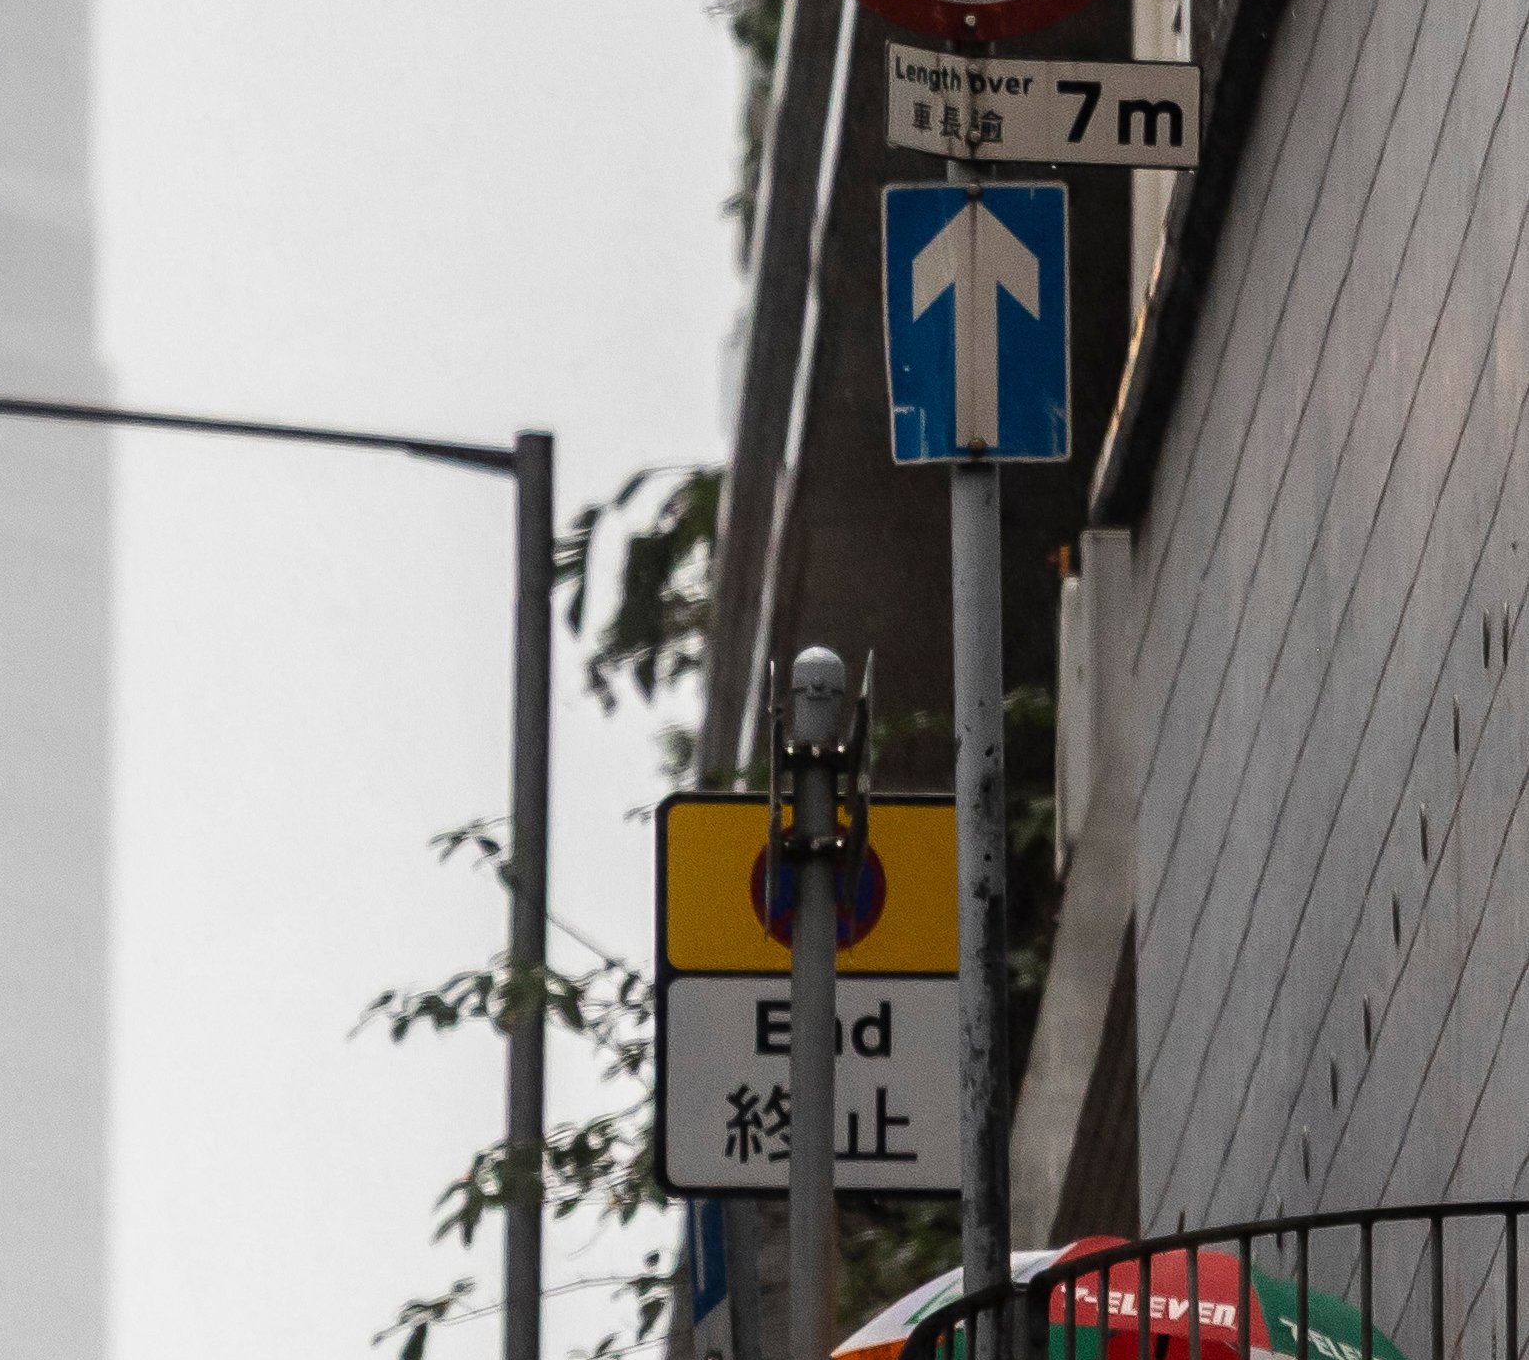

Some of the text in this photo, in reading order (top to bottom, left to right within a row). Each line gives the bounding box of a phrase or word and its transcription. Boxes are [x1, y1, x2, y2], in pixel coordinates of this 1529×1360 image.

[894, 56, 1034, 95] Length over
[1057, 80, 1184, 147] 7 m
